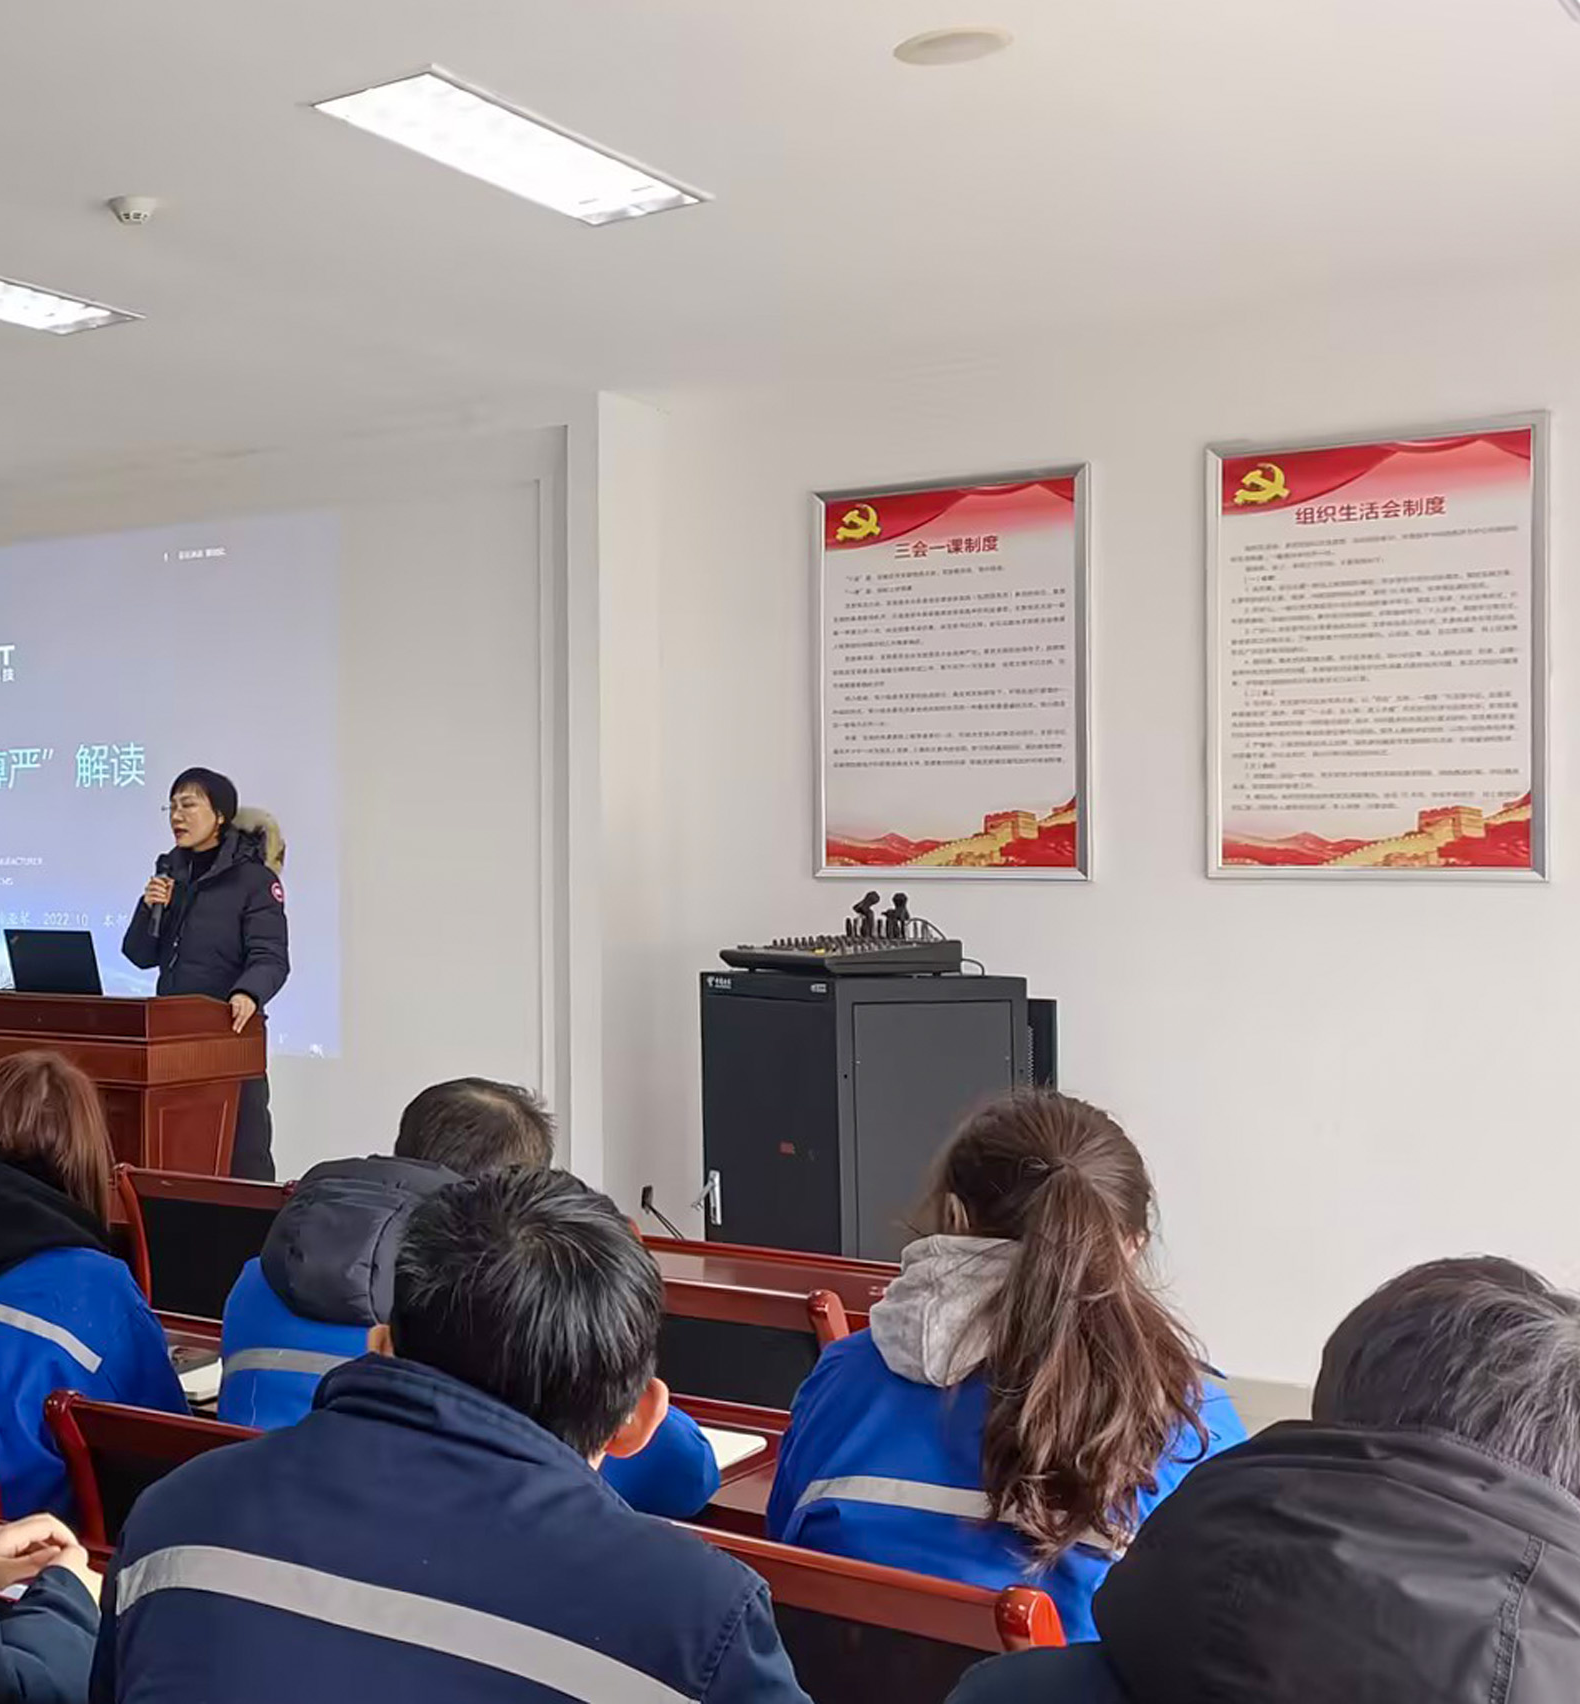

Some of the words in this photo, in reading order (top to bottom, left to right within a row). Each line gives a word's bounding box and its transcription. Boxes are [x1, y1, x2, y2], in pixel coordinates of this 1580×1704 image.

[1295, 496, 1447, 526] 组织生活会制度
[894, 535, 999, 559] 三会一课制度
[75, 742, 146, 788] 解读
